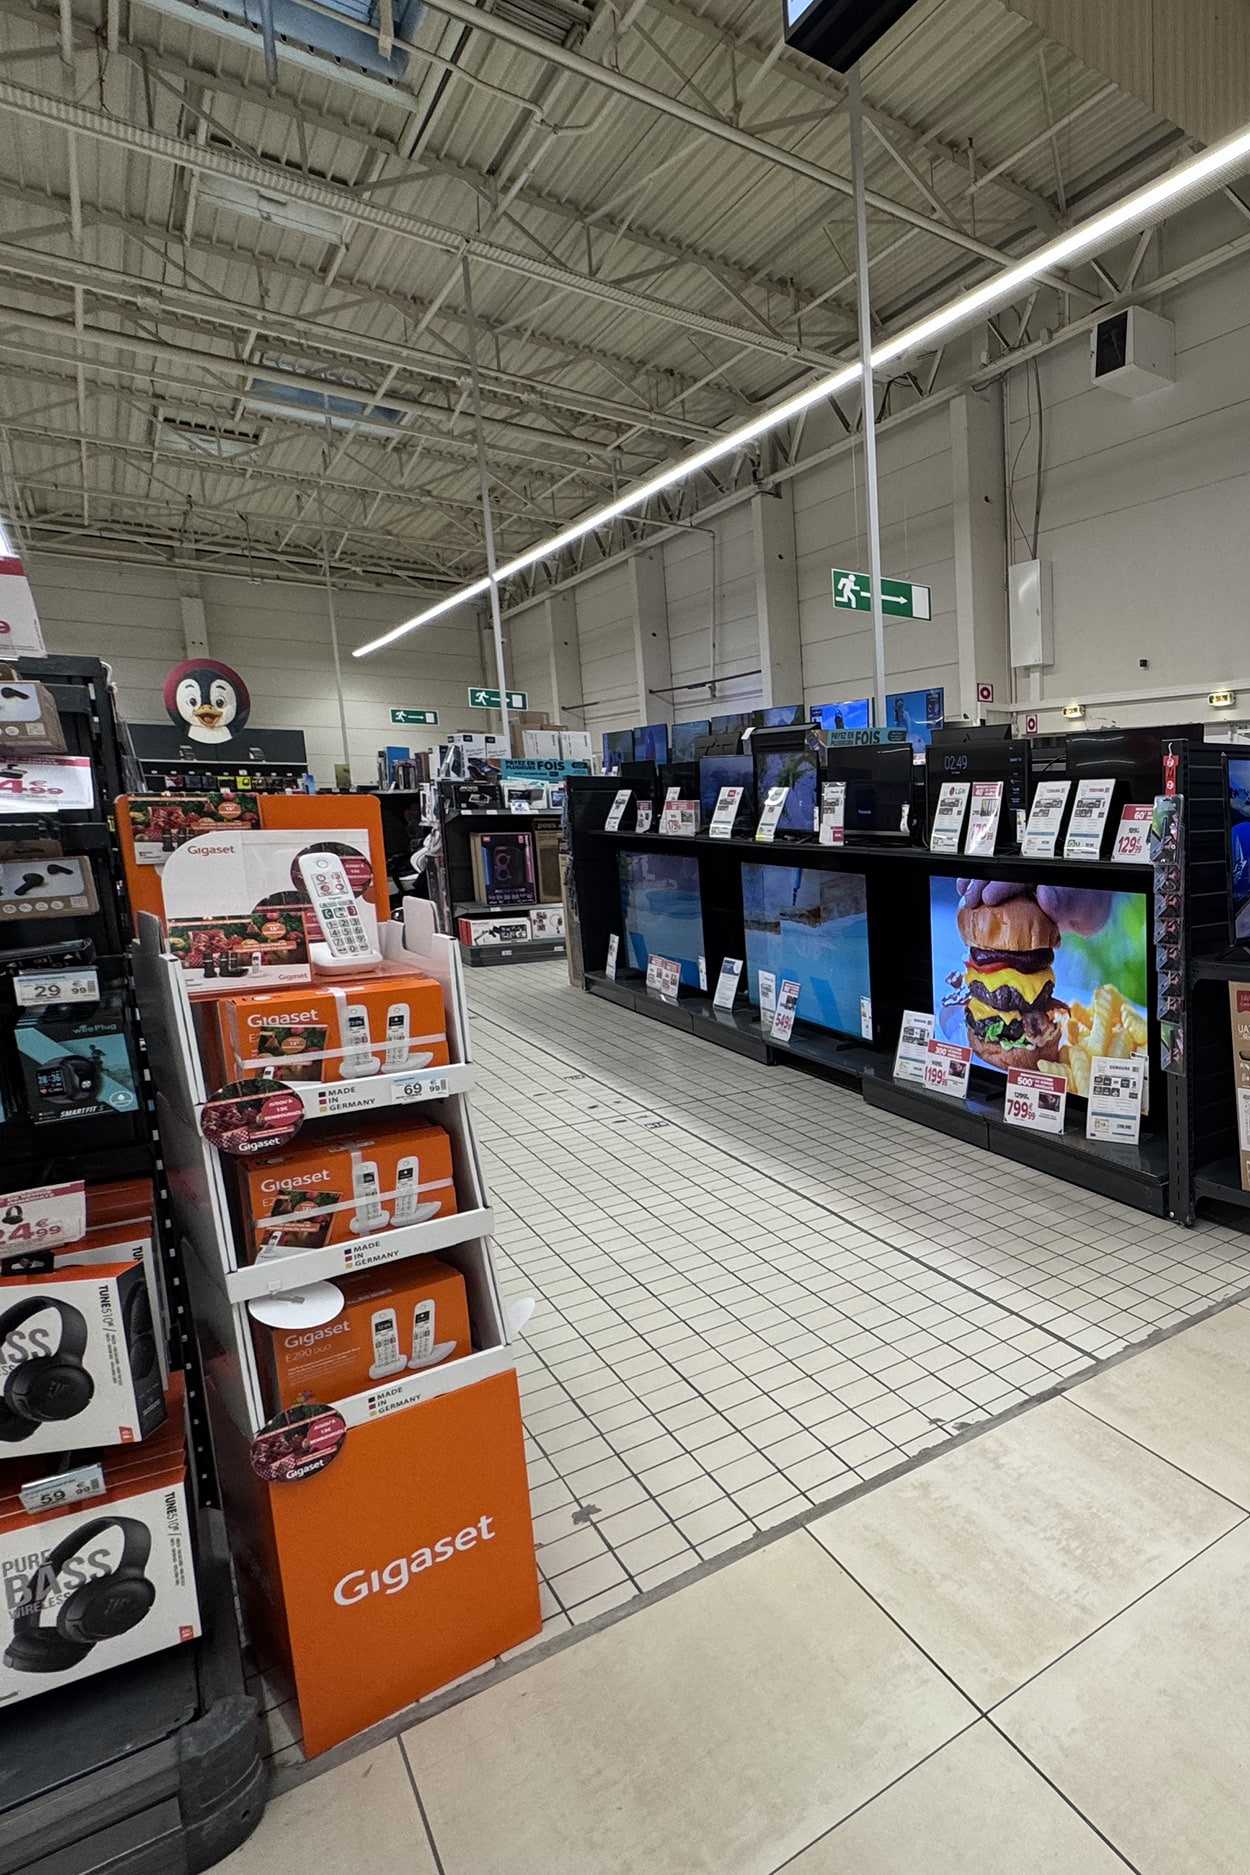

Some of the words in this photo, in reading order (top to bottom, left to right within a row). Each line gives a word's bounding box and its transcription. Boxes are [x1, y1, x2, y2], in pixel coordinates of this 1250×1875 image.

[855, 730, 880, 744] FOIS
[537, 761, 565, 771] FOIS
[187, 845, 235, 856] Gigaset
[278, 973, 308, 981] Gigaset
[34, 984, 61, 998] 29
[247, 1009, 319, 1027] Gigaset
[328, 1087, 356, 1096] MADE
[404, 1083, 422, 1096] 69
[60, 1106, 98, 1118] SMARTFIT
[329, 1098, 376, 1112] GERMANY
[239, 1137, 281, 1152] Gigaset
[261, 1169, 331, 1192] Gigaset
[354, 1241, 381, 1253] MADE
[354, 1252, 364, 1260] IN
[355, 1250, 400, 1267] GERMANY
[284, 1320, 351, 1349] Gigaset
[0, 1328, 52, 1365] SS
[286, 1349, 312, 1363] E290
[377, 1386, 403, 1400] MADE
[379, 1393, 421, 1414] GERMANY
[286, 1459, 325, 1479] Gigaset
[40, 1490, 66, 1504] 59
[2, 1550, 53, 1578] PURE
[333, 1514, 496, 1606] Gigaset
[4, 1548, 114, 1609] BASS
